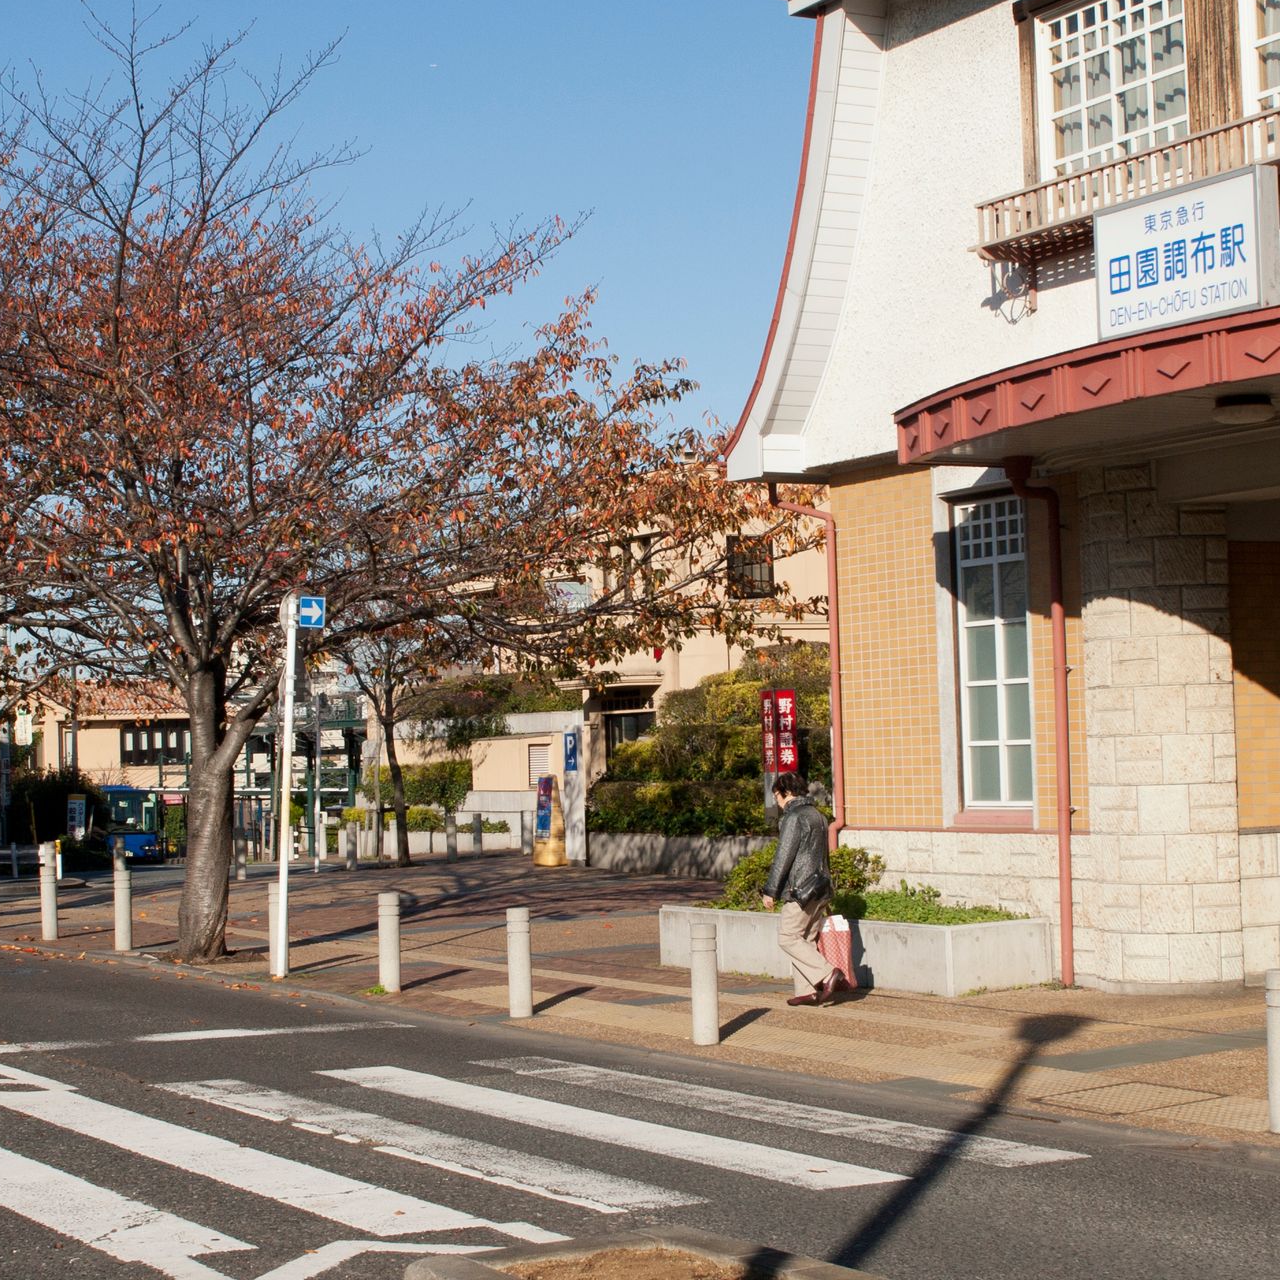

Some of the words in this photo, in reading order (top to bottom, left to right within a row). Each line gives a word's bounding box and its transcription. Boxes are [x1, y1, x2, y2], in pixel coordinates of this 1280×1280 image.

[1144, 201, 1206, 235] 東京急行
[1109, 223, 1247, 295] 田園調布駅
[1110, 289, 1196, 327] DEN-EN-CHŌFU
[1200, 277, 1248, 306] STATION
[566, 735, 575, 756] P
[778, 698, 795, 765] 野村證券
